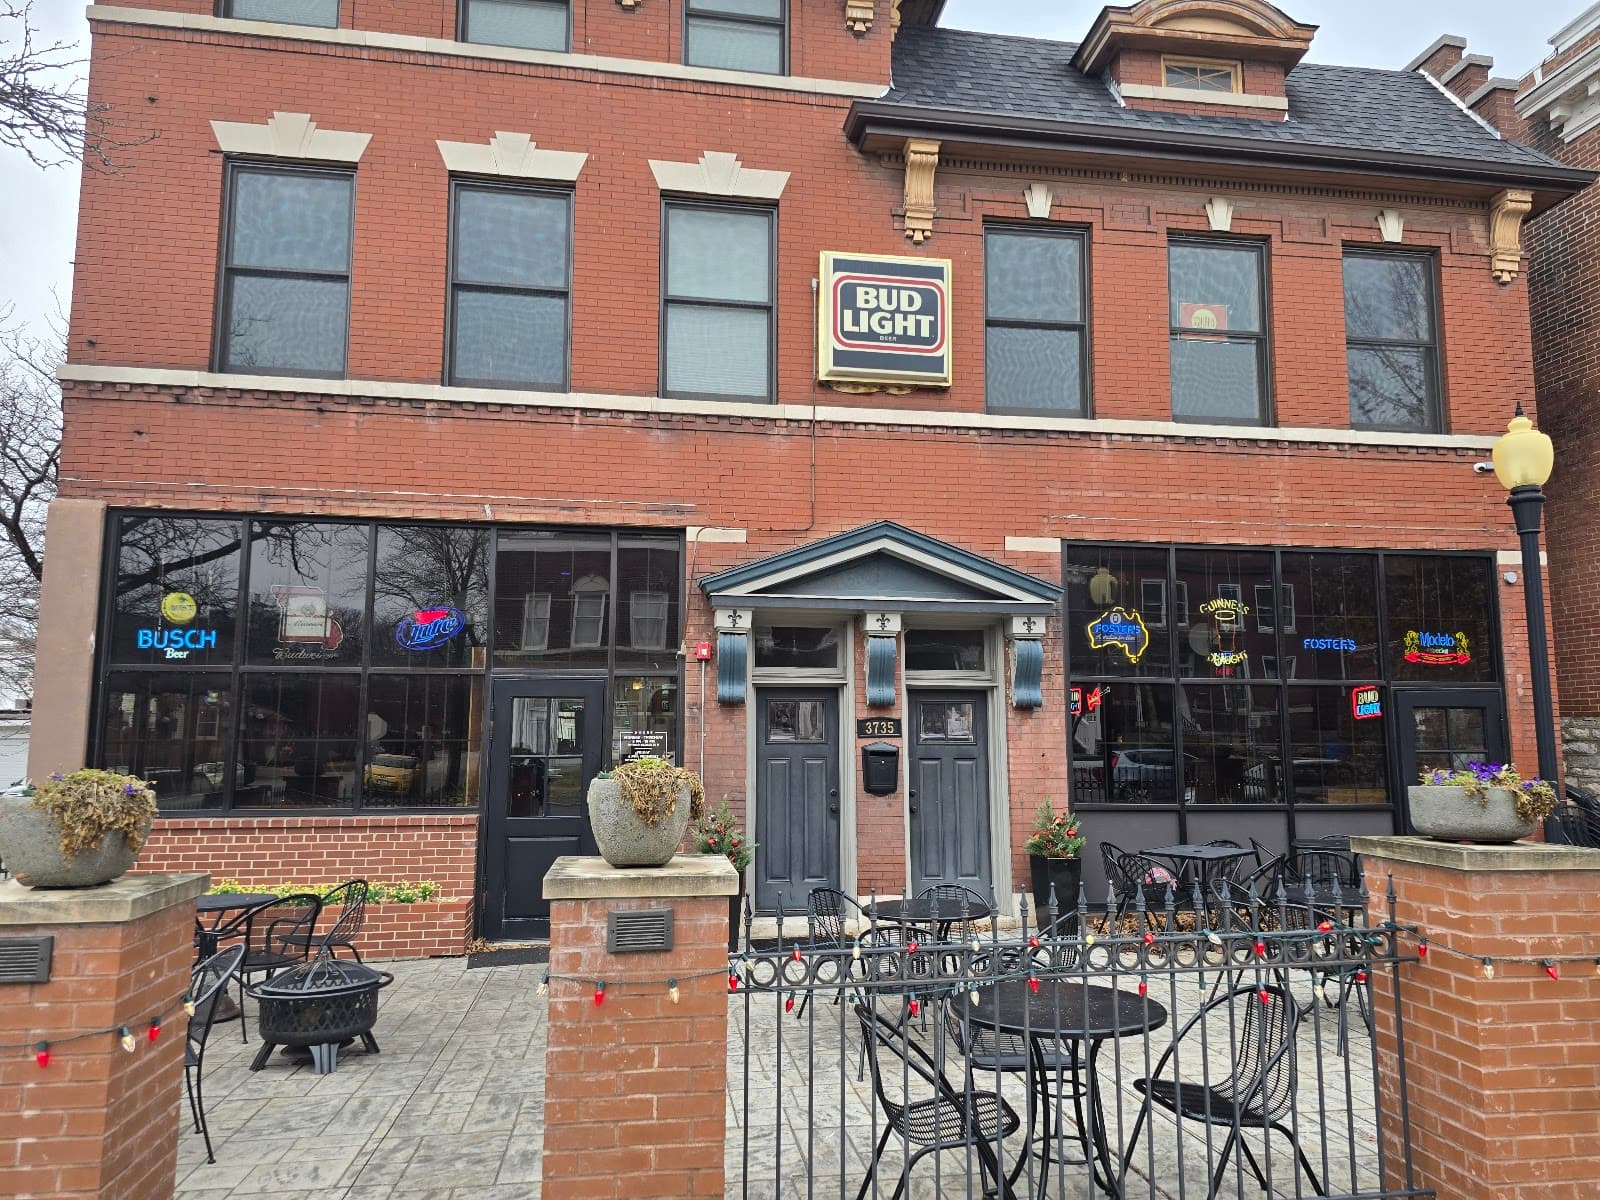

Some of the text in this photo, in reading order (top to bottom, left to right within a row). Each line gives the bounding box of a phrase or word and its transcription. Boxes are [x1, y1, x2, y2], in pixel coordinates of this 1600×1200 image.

[856, 286, 922, 312] BUD
[843, 309, 935, 338] LIGHT
[1199, 598, 1250, 615] GUINNESS
[137, 628, 216, 649] BUSCH
[1303, 638, 1357, 651] FOSTER'S
[1419, 631, 1455, 648] Modelo
[163, 647, 190, 659] Beer
[1358, 690, 1379, 705] BUD
[1356, 702, 1381, 716] LIGHT
[865, 721, 895, 735] 3735
